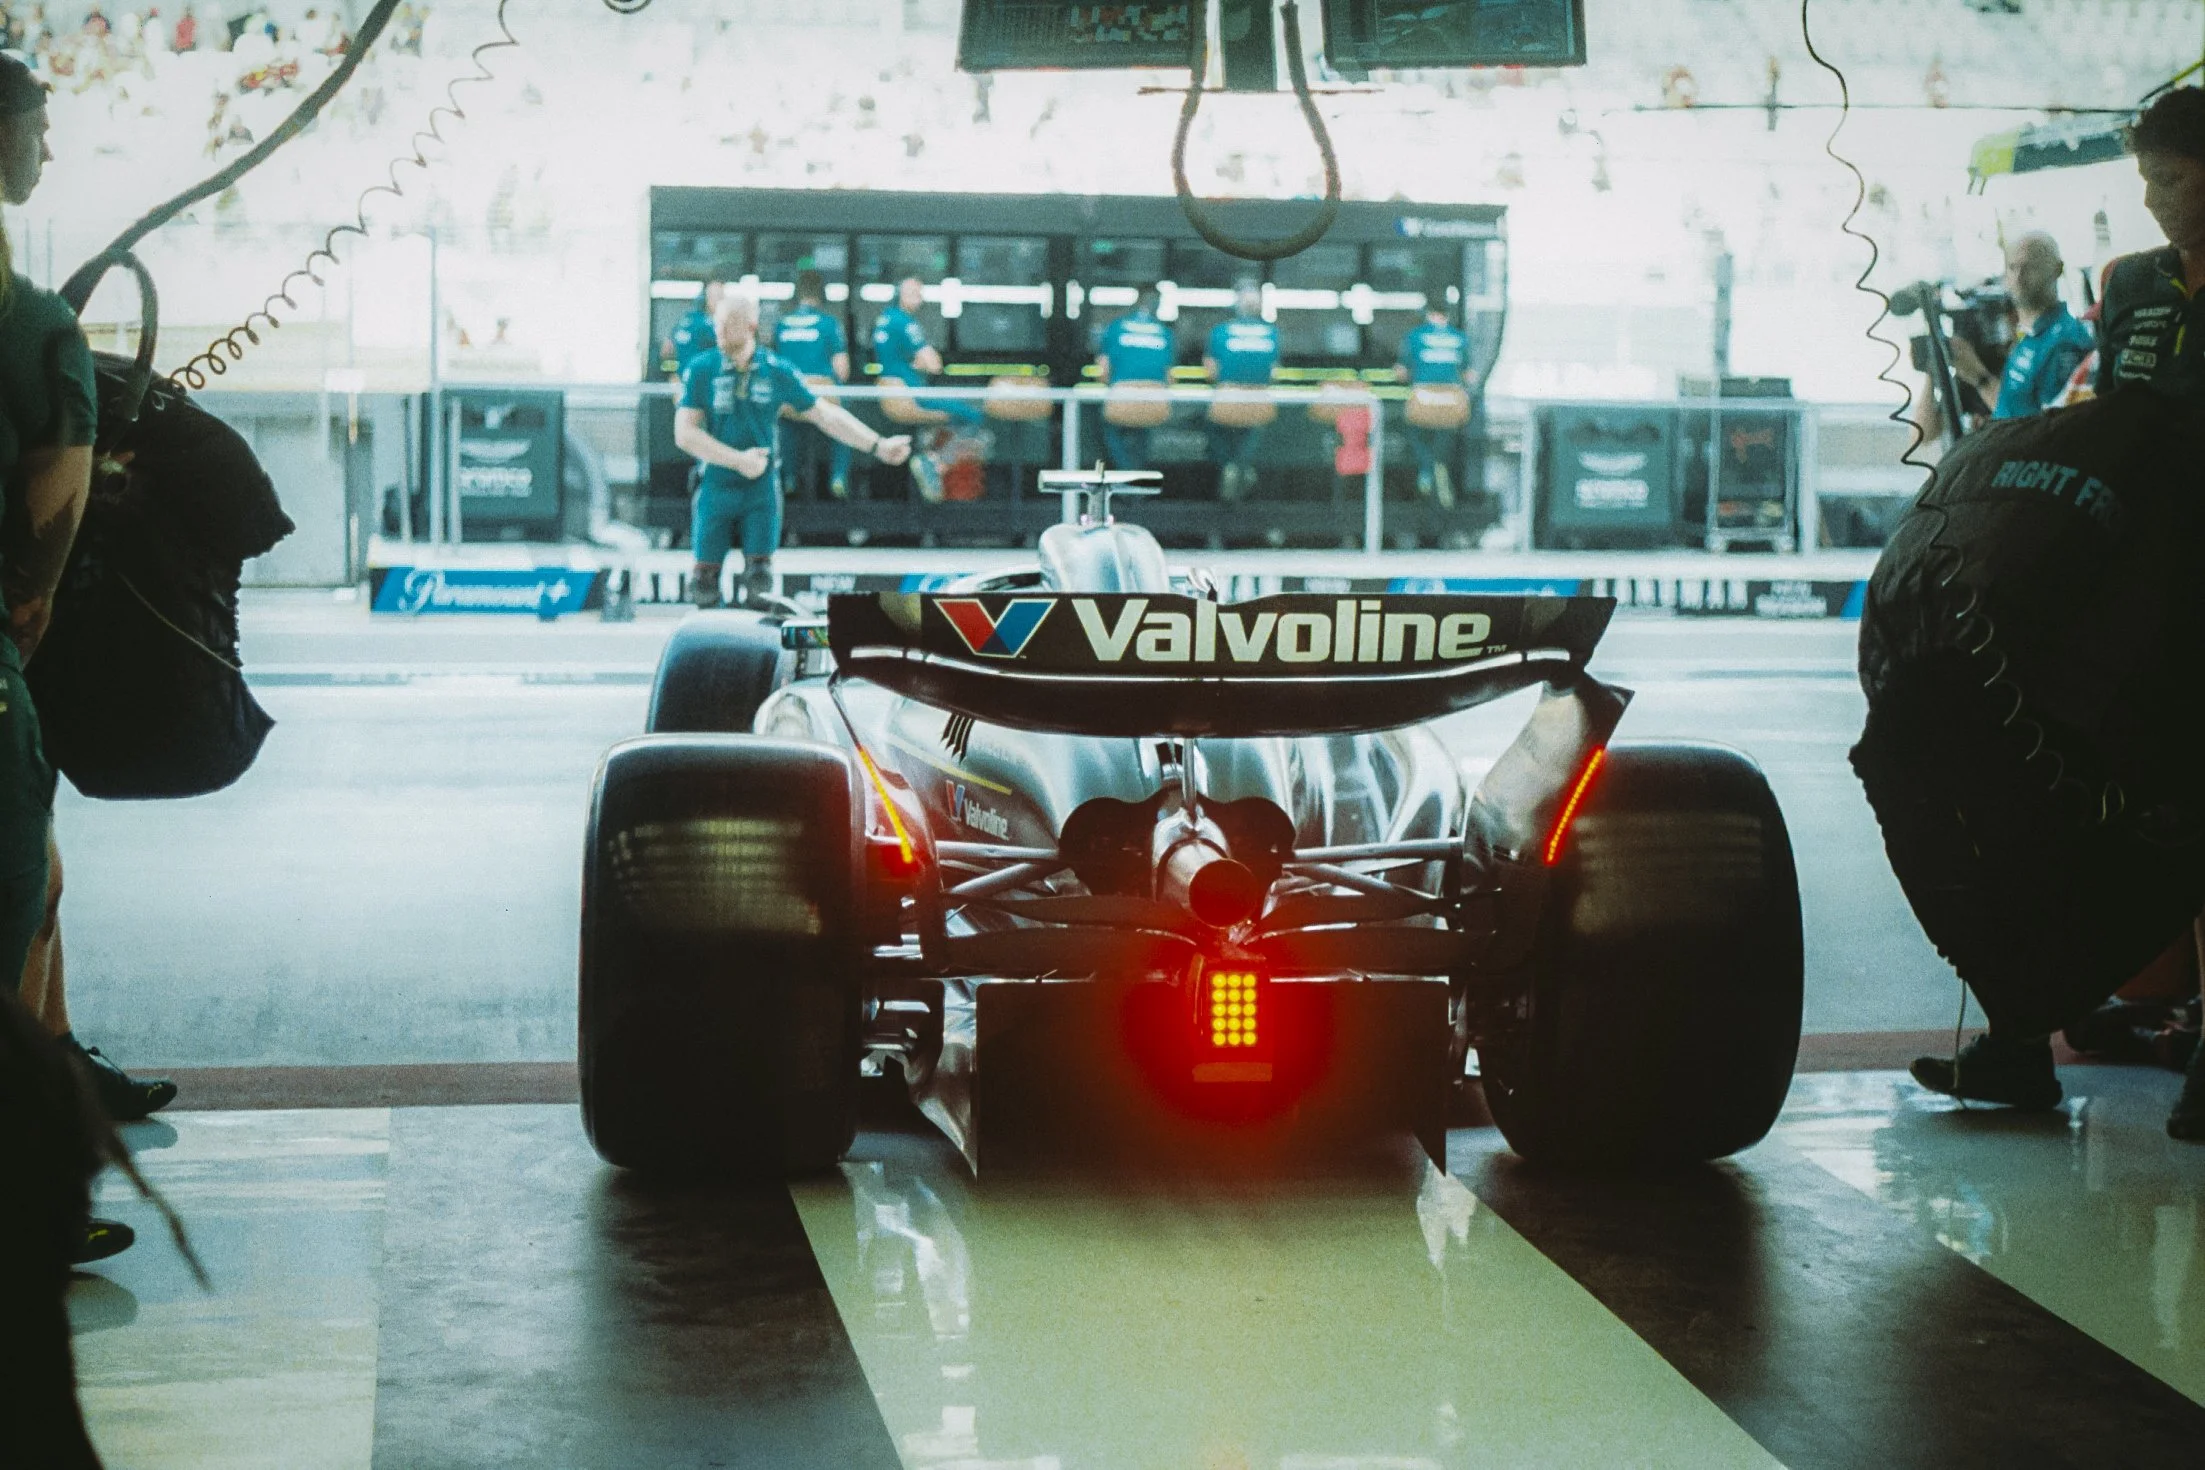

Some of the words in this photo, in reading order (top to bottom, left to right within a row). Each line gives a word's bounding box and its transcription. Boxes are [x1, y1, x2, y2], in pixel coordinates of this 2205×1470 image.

[1992, 461, 2078, 495] RIGHT
[1072, 598, 1491, 662] Valvoline
[964, 798, 1009, 840] Valvoline
